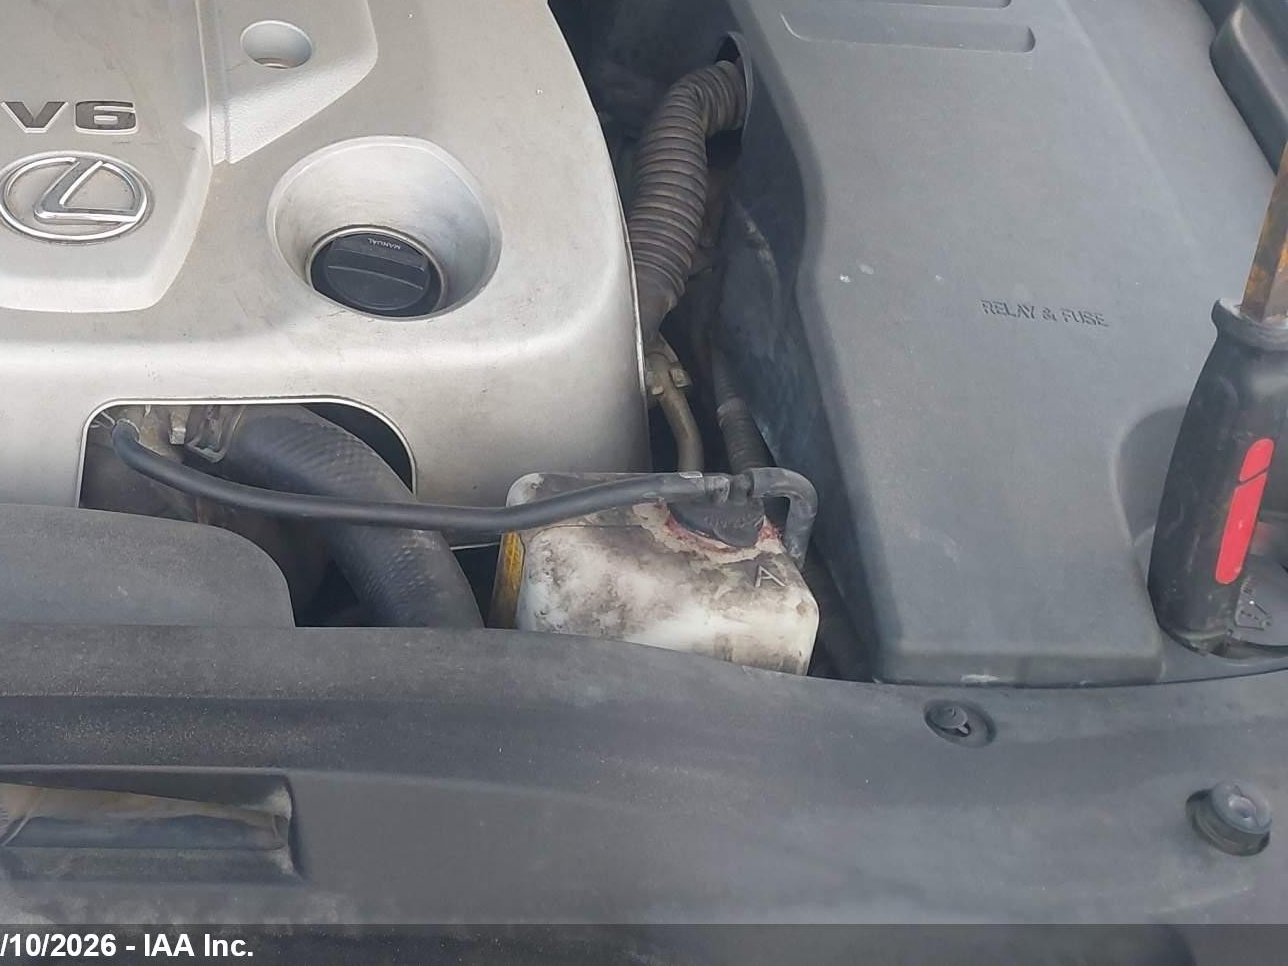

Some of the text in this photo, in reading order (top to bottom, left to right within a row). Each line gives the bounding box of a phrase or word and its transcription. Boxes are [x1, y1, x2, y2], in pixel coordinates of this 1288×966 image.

[1, 99, 138, 135] V6
[367, 237, 402, 250] MANUAL
[979, 298, 1110, 328] RELAY & FUSE
